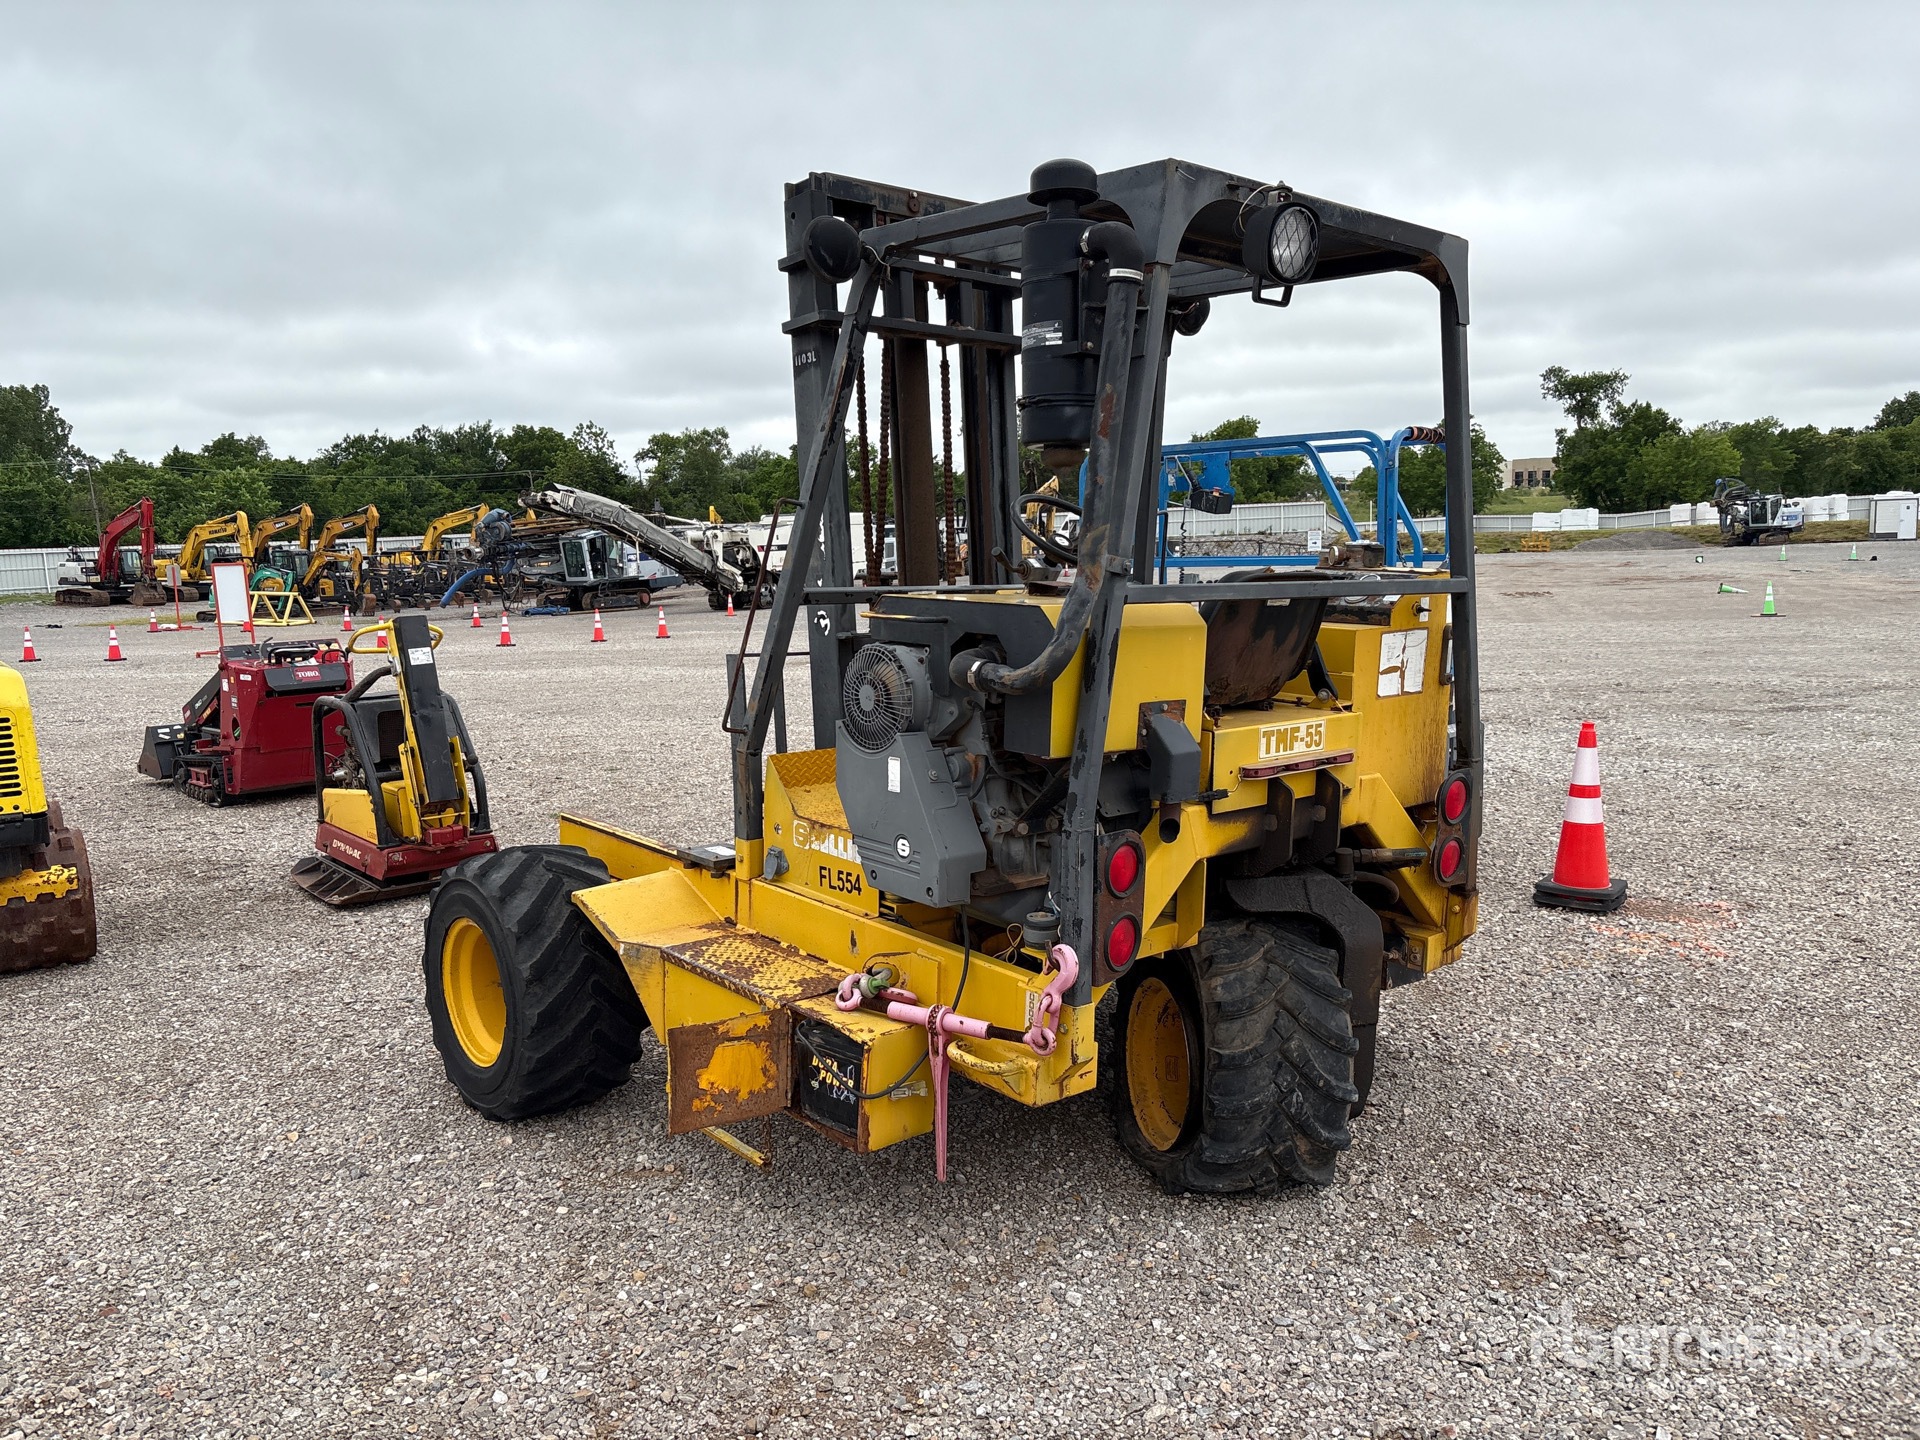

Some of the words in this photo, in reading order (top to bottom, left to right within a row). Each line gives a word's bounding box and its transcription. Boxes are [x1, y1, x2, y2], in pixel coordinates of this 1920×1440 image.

[295, 670, 320, 678] TORO
[1262, 723, 1323, 755] TMF-55
[819, 865, 862, 896] FL554
[819, 1069, 855, 1090] POWR
